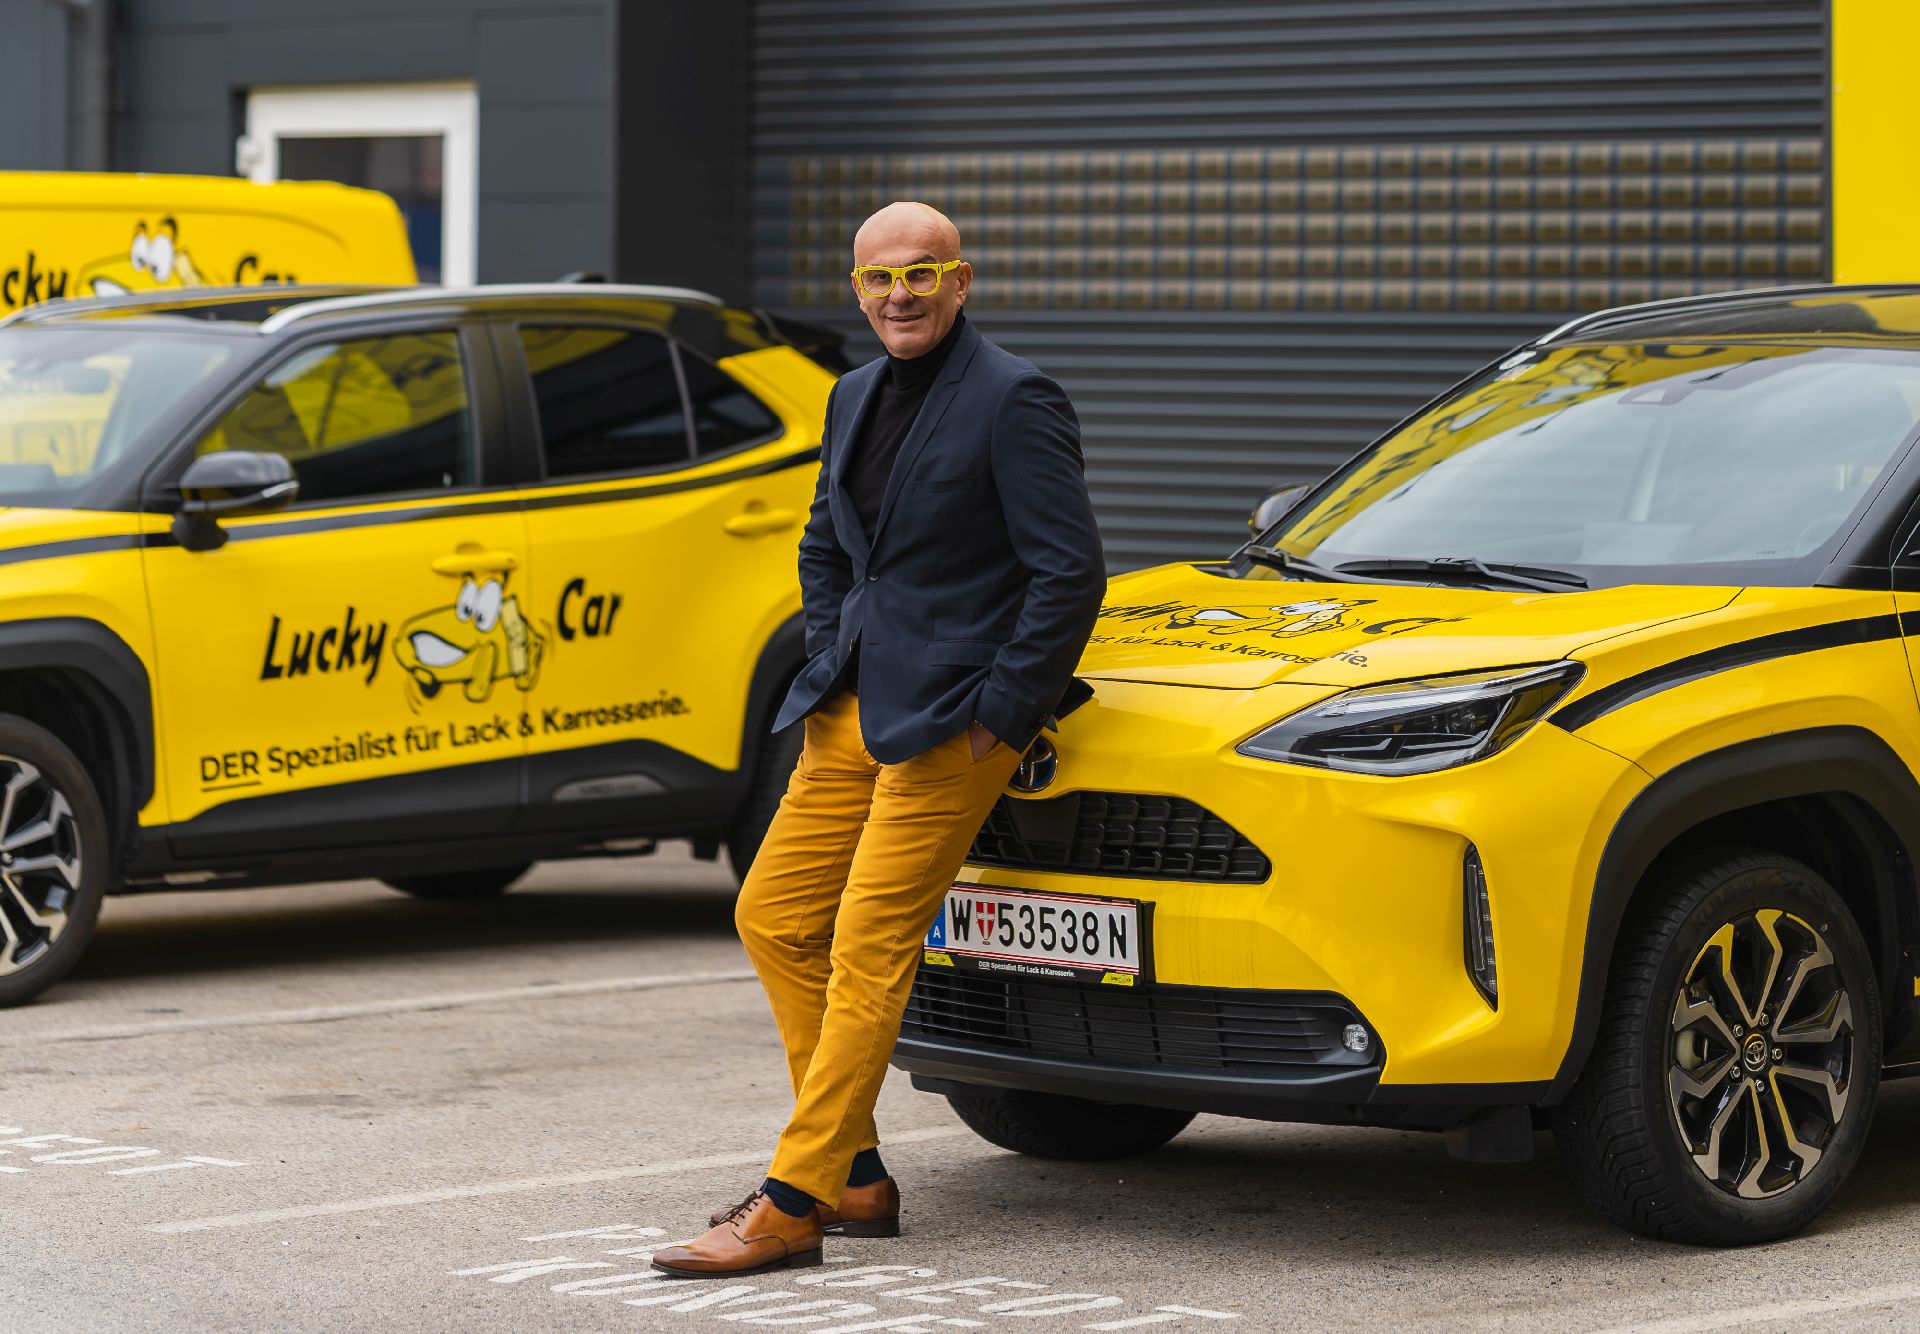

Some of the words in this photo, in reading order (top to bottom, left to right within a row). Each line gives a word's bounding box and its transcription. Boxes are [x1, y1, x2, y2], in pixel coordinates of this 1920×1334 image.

[259, 605, 388, 687] Lucky
[557, 577, 623, 642] Car
[200, 751, 260, 792] DER
[266, 731, 398, 778] Spezialist
[402, 725, 441, 755] für
[449, 713, 512, 747] Lack
[517, 711, 534, 738] &
[541, 688, 691, 735] Karrosserie.
[932, 925, 942, 939] A
[950, 896, 972, 942] W
[997, 902, 1100, 956] 53538
[1108, 913, 1127, 960] N
[978, 960, 991, 970] DER
[990, 962, 1017, 972] Spezialist
[1017, 964, 1026, 972] für
[1026, 965, 1040, 974] Lack
[446, 1256, 989, 1334] KUNDE
